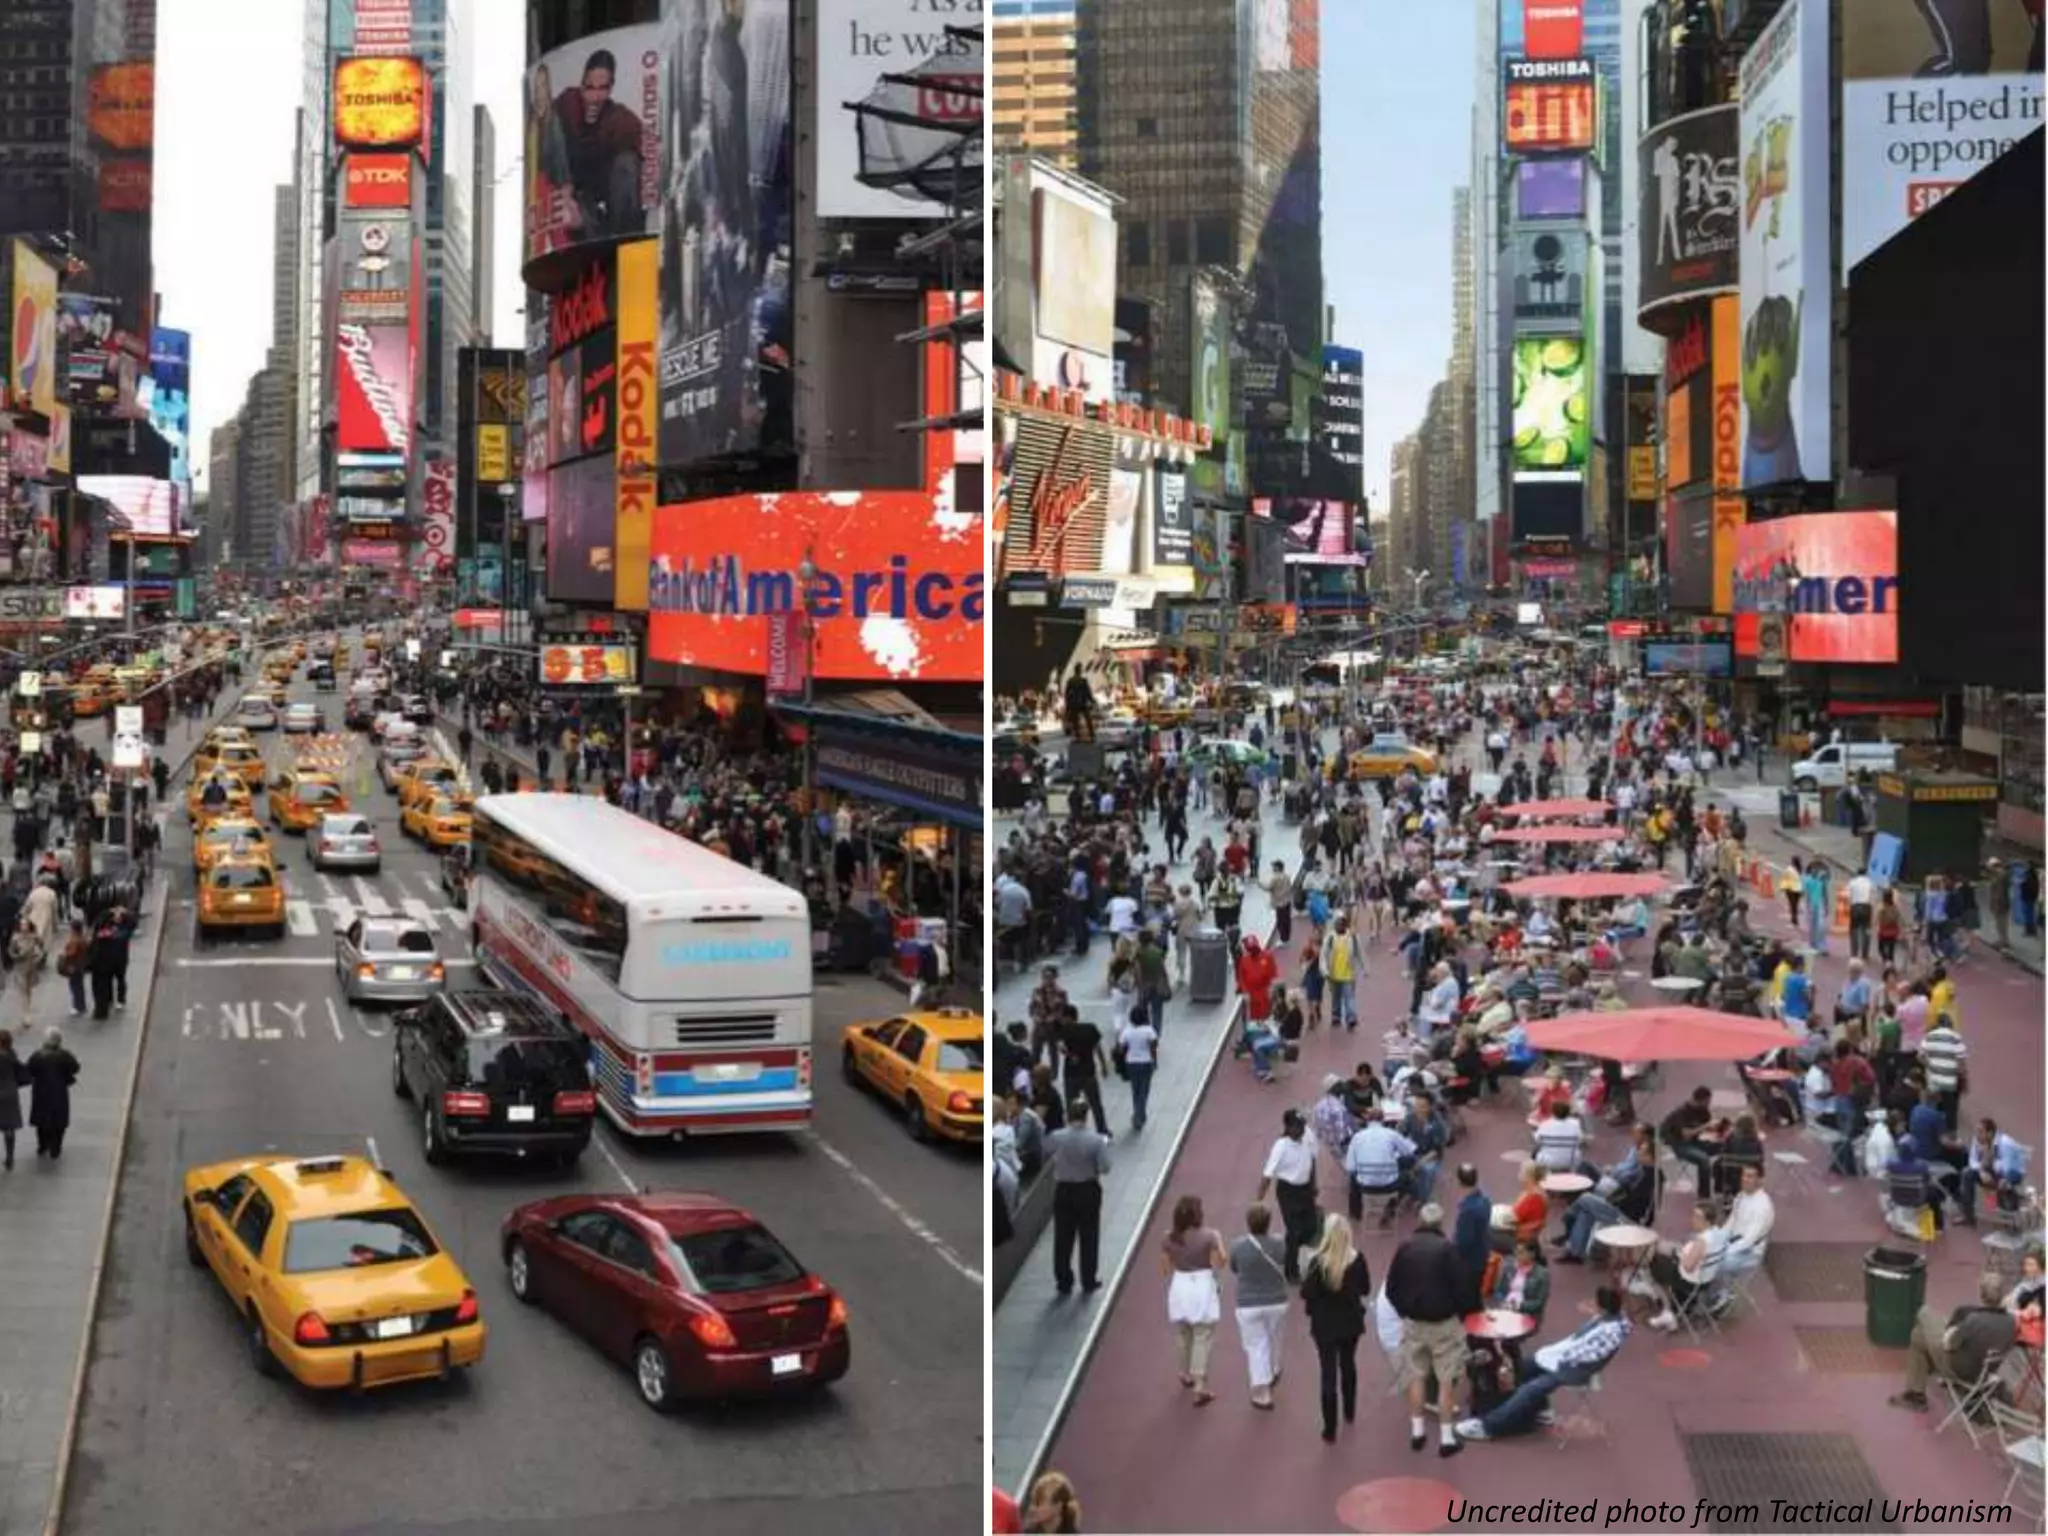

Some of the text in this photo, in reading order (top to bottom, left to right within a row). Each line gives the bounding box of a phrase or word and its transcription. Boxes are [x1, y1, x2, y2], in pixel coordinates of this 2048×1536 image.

[850, 20, 972, 57] he was
[1510, 60, 1591, 78] TOSHIBA
[346, 93, 413, 106] TOSHIBA
[1886, 84, 2010, 132] Helped
[364, 168, 408, 184] TDK
[621, 341, 653, 513] Kodak
[1716, 382, 1743, 530] Kodak
[768, 613, 787, 688] WELCOME
[182, 1000, 307, 1041] ONLY
